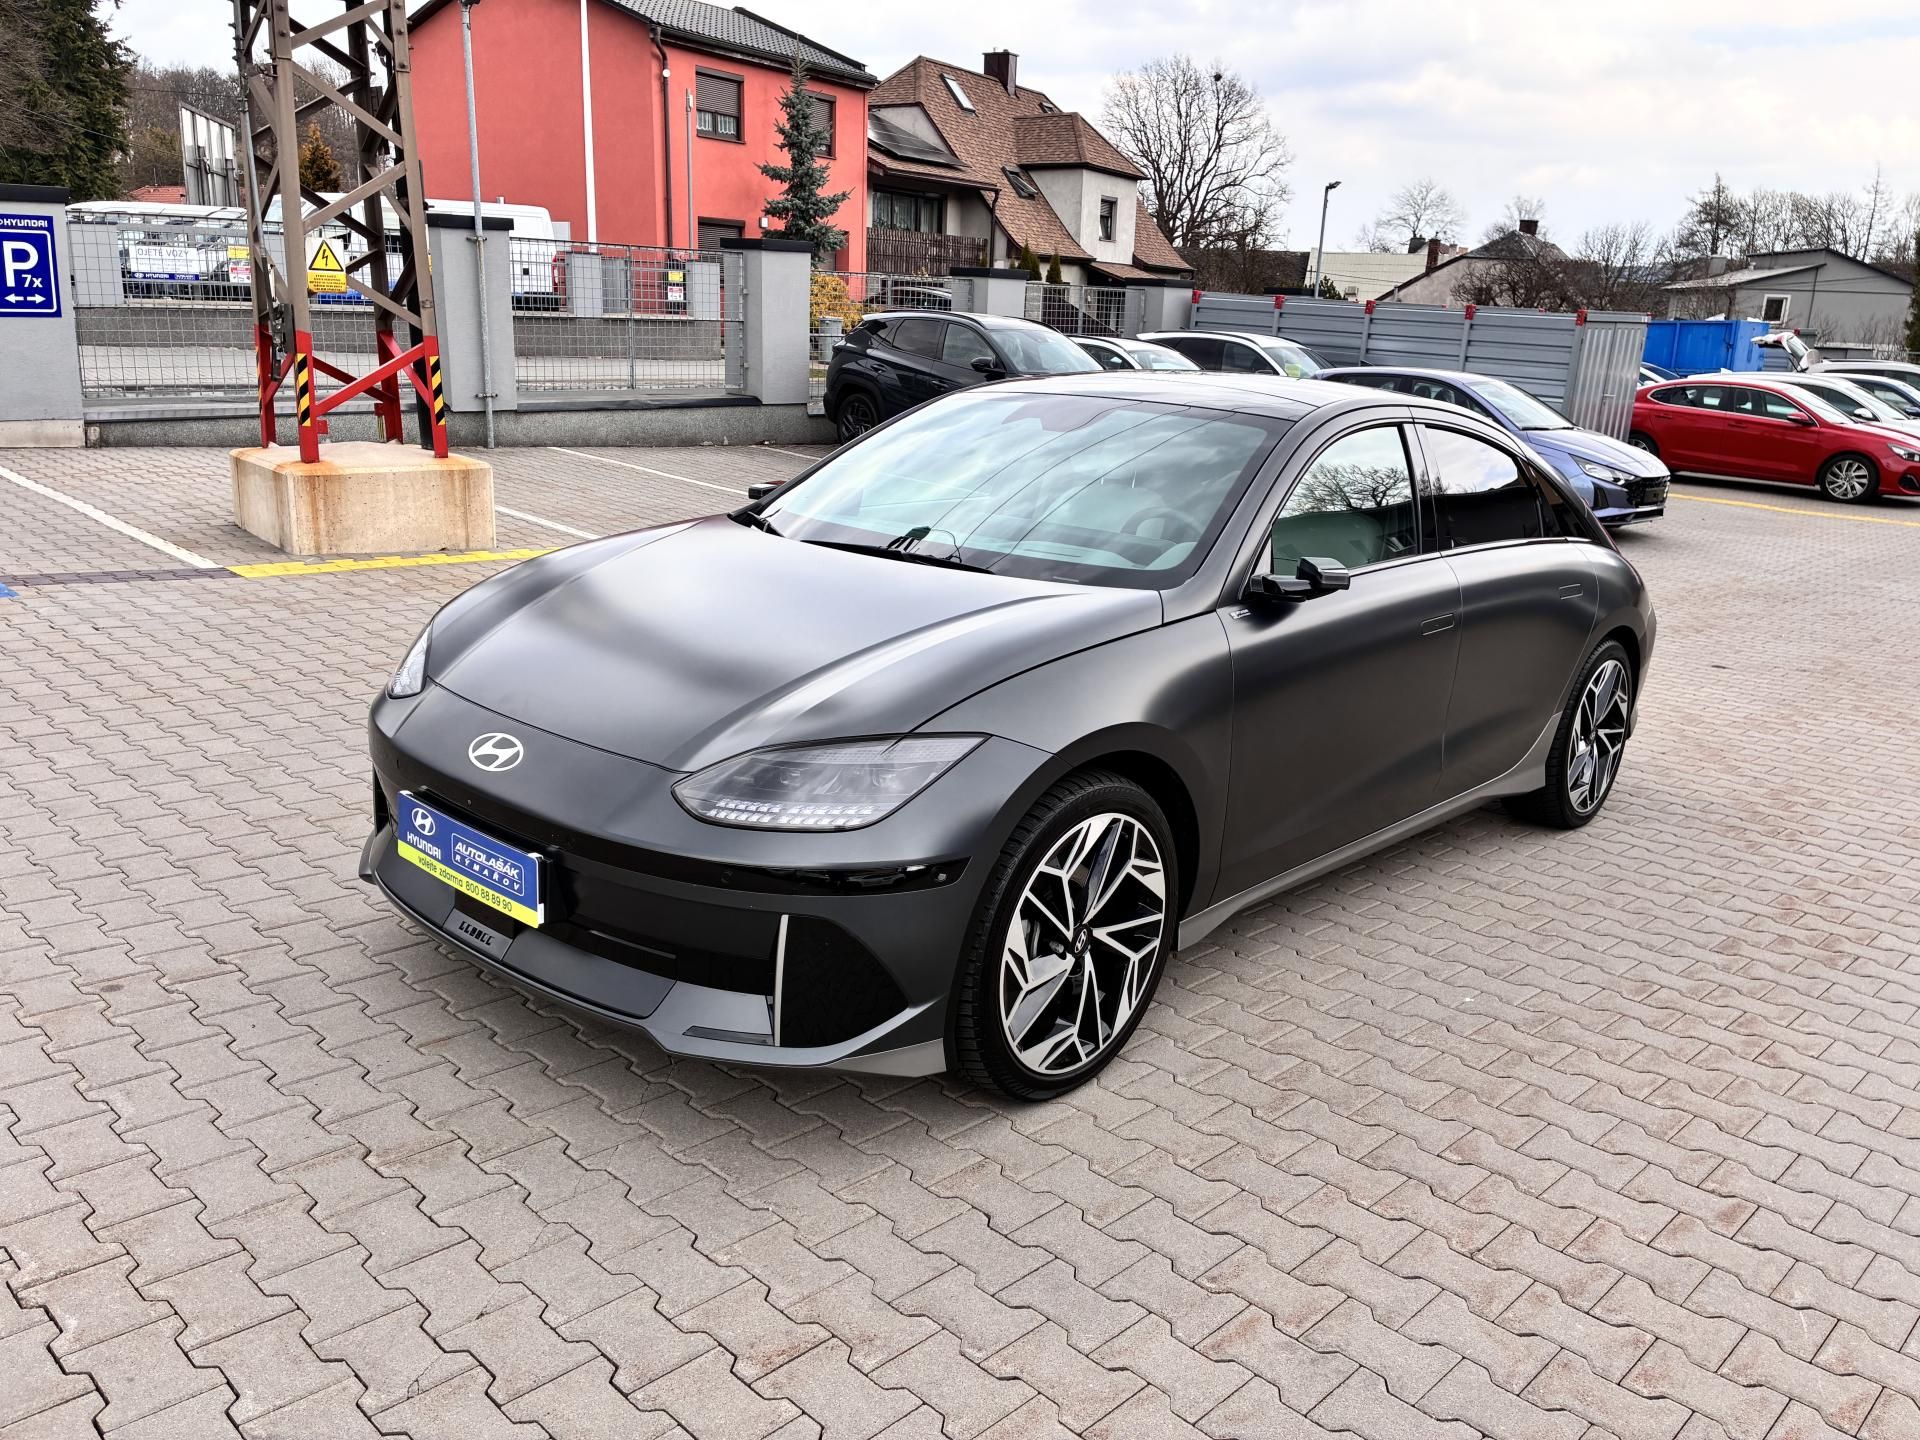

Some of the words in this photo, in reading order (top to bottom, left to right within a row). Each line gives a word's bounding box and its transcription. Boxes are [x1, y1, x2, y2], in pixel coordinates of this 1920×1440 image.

[4, 218, 48, 228] HYUNDAI
[2, 241, 39, 288] P
[165, 249, 189, 257] VOZY
[21, 274, 43, 288] 7x
[407, 831, 441, 860] HYUNDAI
[455, 842, 520, 879] AUTOLAŠÁK
[418, 856, 437, 872] volejte
[439, 868, 463, 887] zdarma
[465, 881, 480, 896] 800
[480, 889, 490, 901] 88
[492, 895, 501, 907] 89
[502, 900, 513, 912] 90
